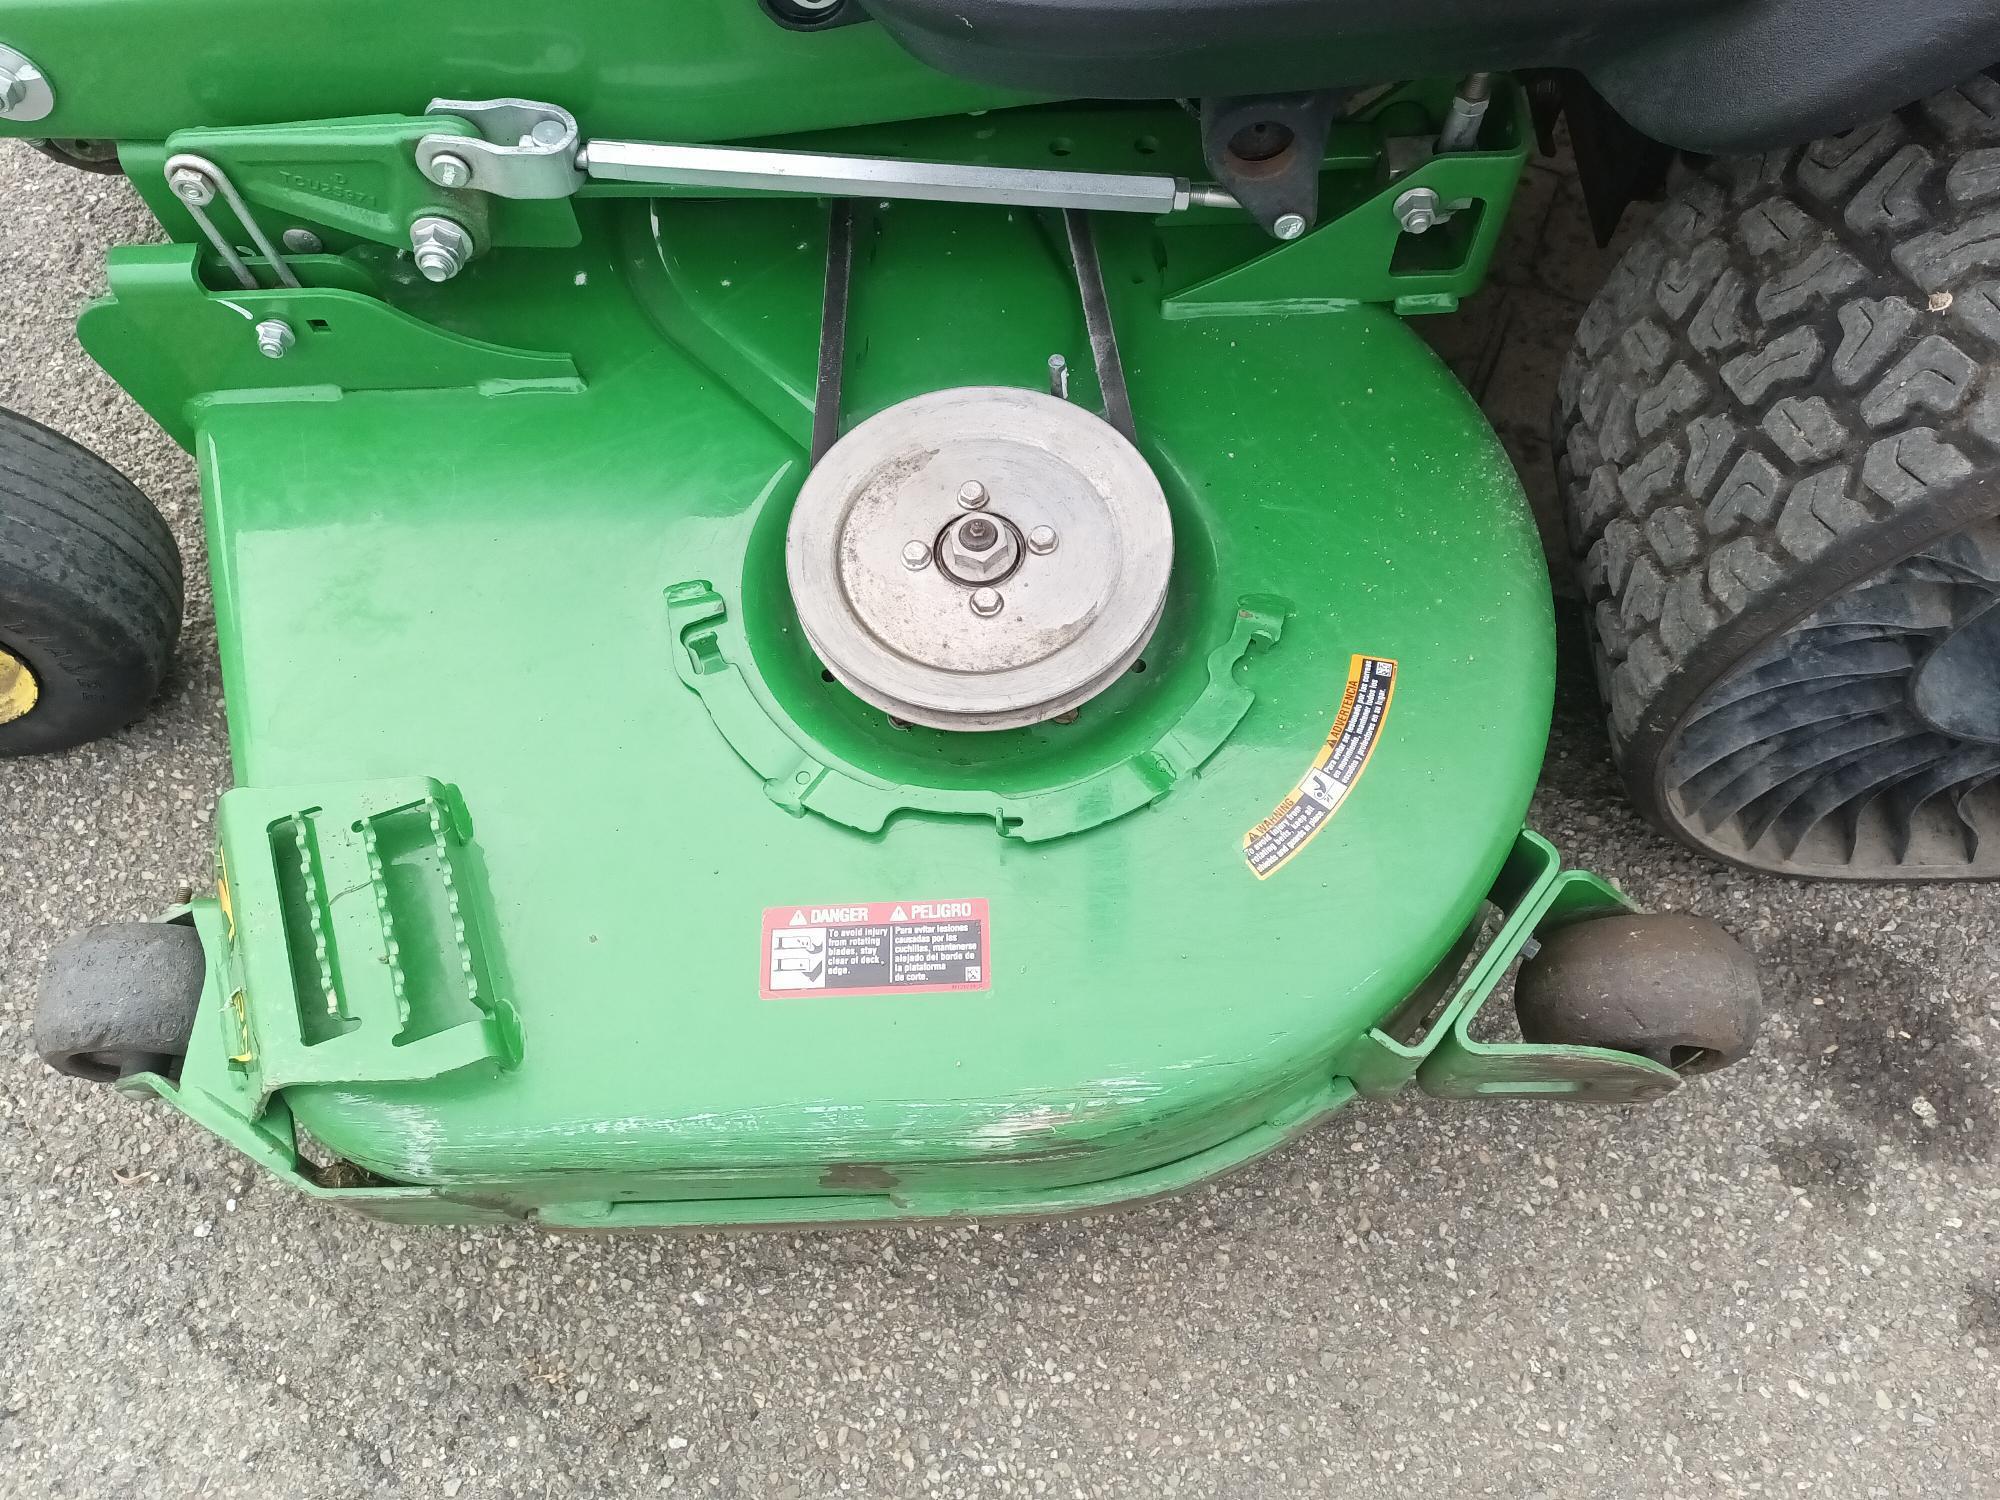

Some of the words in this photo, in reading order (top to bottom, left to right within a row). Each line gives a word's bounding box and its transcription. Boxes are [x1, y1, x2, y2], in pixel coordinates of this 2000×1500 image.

[1362, 661, 1372, 683] correas
[1359, 683, 1368, 693] las
[1369, 679, 1378, 689] los
[1367, 689, 1376, 706] todos
[1331, 680, 1358, 739] ADVERTENCIA
[1374, 705, 1381, 713] su
[1356, 706, 1371, 734] mantener
[1371, 714, 1379, 722] en
[1342, 733, 1351, 745] ser
[1359, 723, 1376, 756] protectores
[1357, 753, 1363, 761] y
[1324, 759, 1336, 774] Para
[1341, 760, 1358, 783] escudos
[1333, 769, 1340, 778] en
[1254, 832, 1272, 850] avoid
[1270, 819, 1290, 837] injury
[1287, 805, 1302, 820] from
[1251, 844, 1277, 864] rotating
[1290, 815, 1307, 829] keep
[1305, 805, 1315, 815] all
[1257, 854, 1278, 872] shields
[1277, 845, 1289, 857] and
[1288, 830, 1306, 848] guards
[1302, 824, 1311, 832] in
[1309, 811, 1325, 827] place.
[811, 908, 868, 923] DANGER
[911, 903, 971, 919] PELIGRO
[829, 928, 839, 936] To
[865, 928, 888, 938] injury
[895, 927, 912, 935] Para
[914, 925, 935, 933] evitar
[937, 924, 968, 932] lesiones
[829, 938, 846, 946] from
[849, 938, 880, 947] rotating
[932, 935, 943, 944] por
[946, 933, 957, 942] las
[861, 947, 877, 956] stay
[895, 945, 930, 953] cuchillas,
[933, 943, 977, 951] mantenerse
[828, 956, 848, 965] clear
[851, 956, 859, 964] of
[895, 954, 924, 963] alejado
[926, 953, 938, 961] del
[941, 952, 962, 960] borde
[965, 952, 975, 960] de
[828, 967, 850, 975] edge.
[895, 964, 902, 972] la
[904, 962, 946, 972] plataforma
[895, 973, 904, 981] de
[906, 972, 928, 981] corte.
